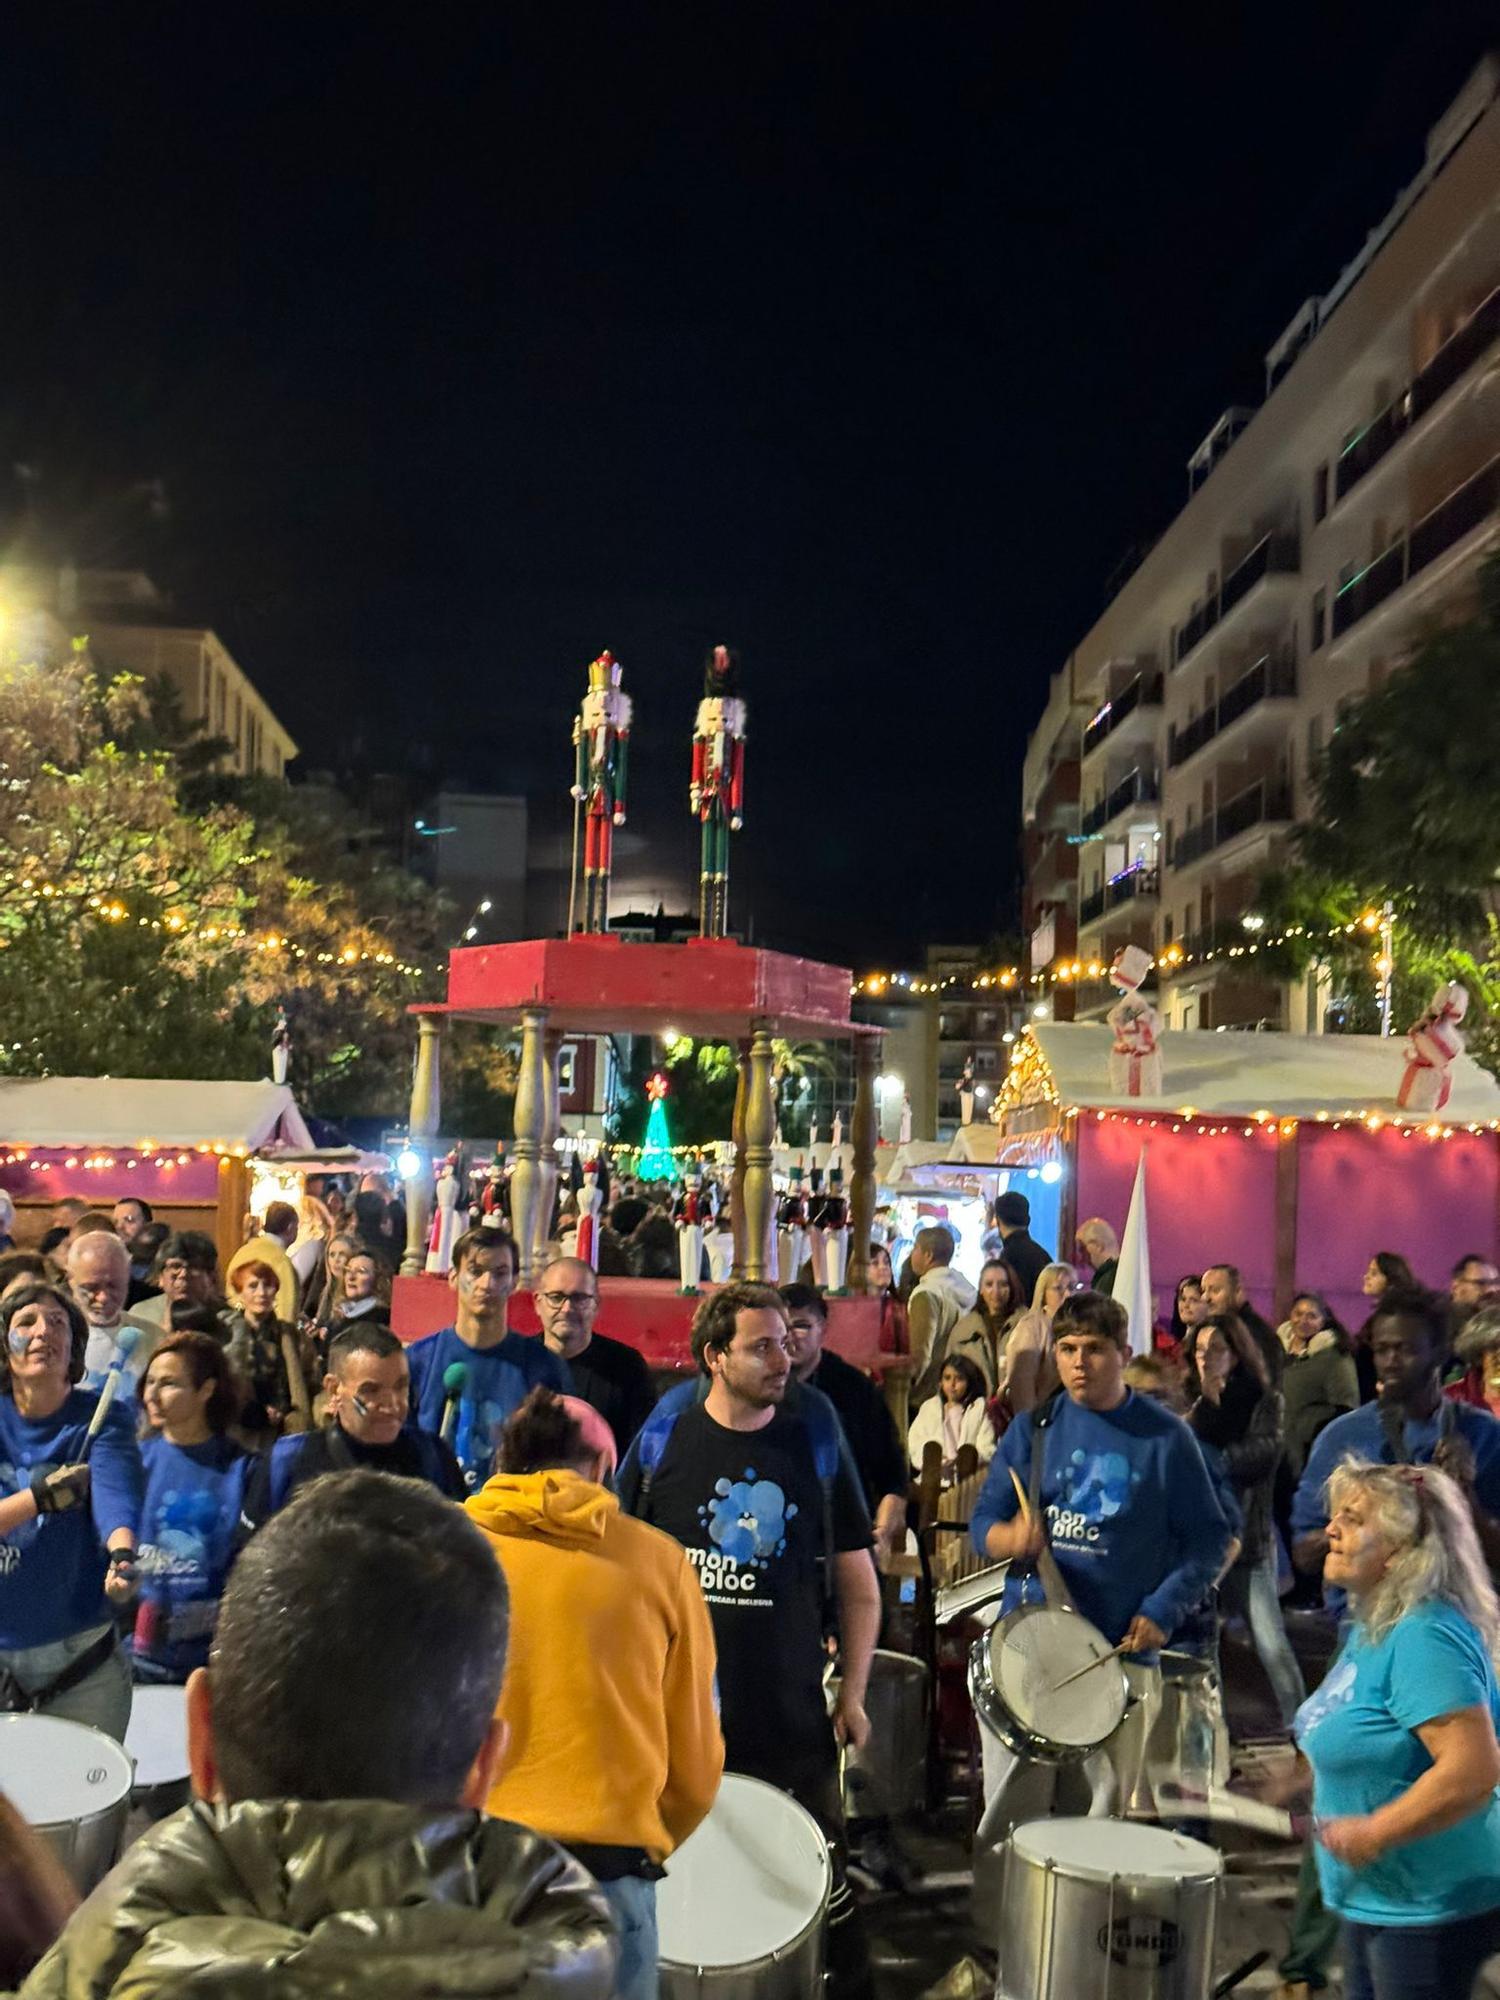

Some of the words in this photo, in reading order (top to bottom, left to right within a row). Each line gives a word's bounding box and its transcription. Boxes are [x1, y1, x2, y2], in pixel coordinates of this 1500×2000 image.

[1052, 1519, 1100, 1541] bloc
[684, 1547, 738, 1572] mon
[700, 1566, 756, 1591] bloc
[703, 1594, 736, 1604] ATUCADA
